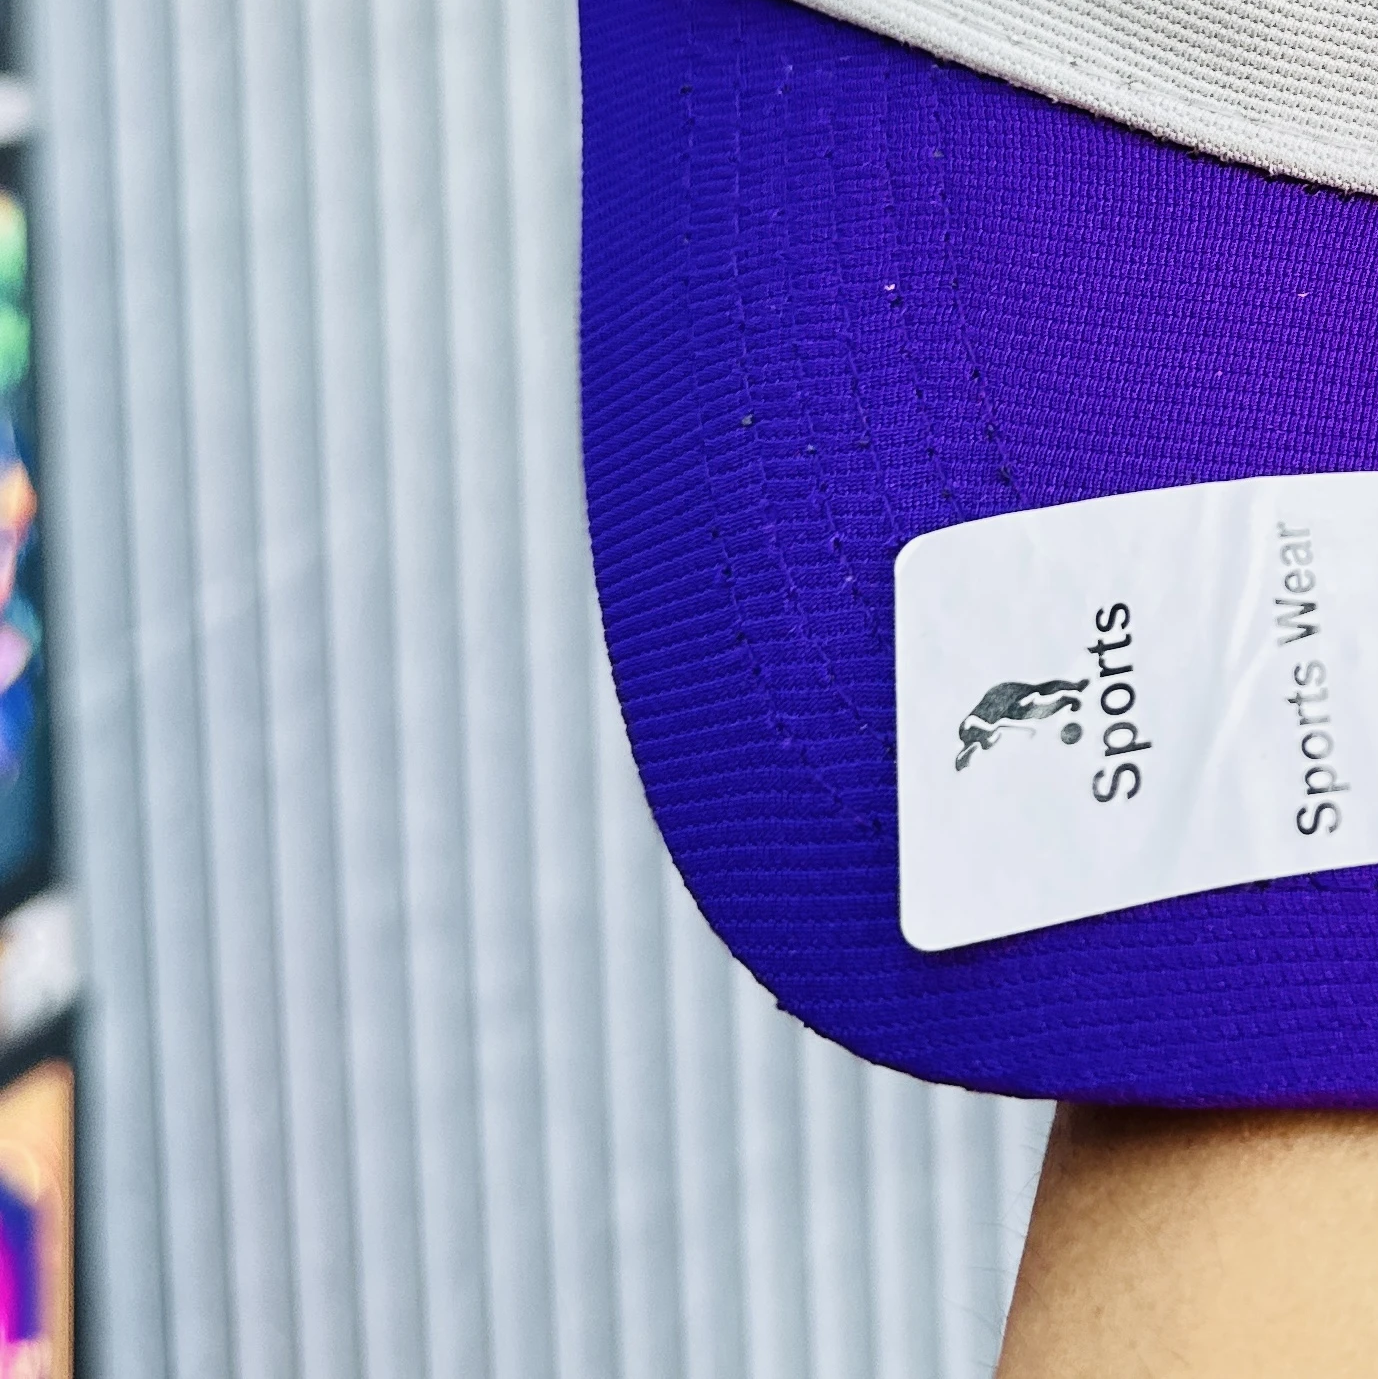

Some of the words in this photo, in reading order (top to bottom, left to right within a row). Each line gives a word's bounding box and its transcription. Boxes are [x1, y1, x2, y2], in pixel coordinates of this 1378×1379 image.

[1274, 521, 1320, 647] Wear
[1087, 602, 1152, 803] Sports
[1287, 659, 1350, 835] Sports
